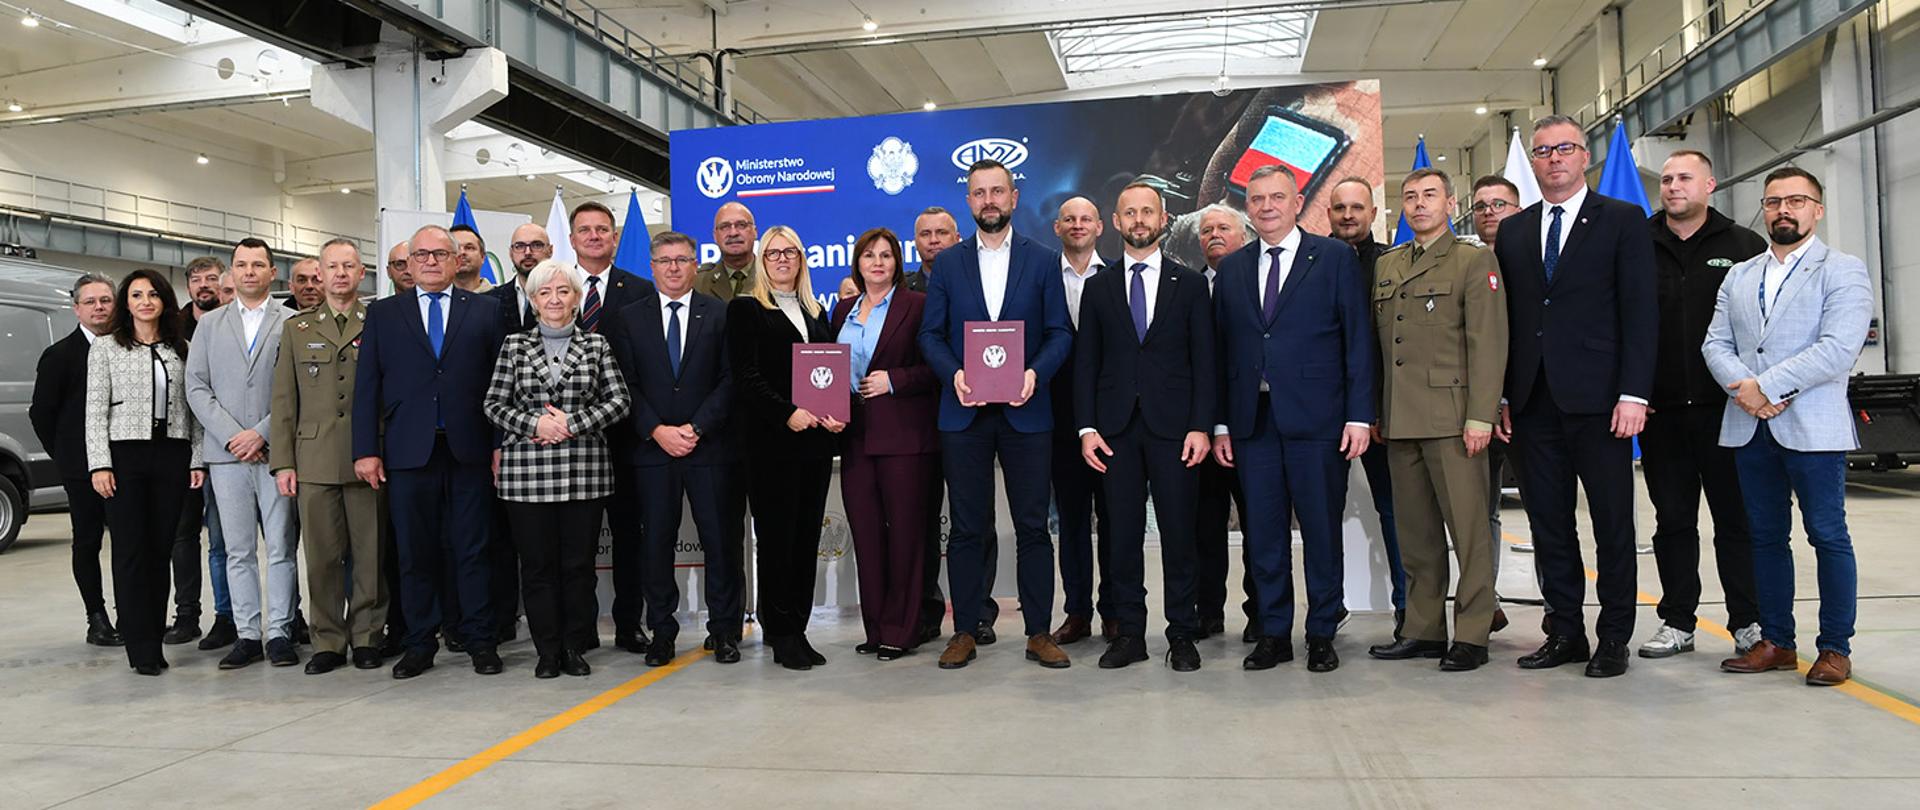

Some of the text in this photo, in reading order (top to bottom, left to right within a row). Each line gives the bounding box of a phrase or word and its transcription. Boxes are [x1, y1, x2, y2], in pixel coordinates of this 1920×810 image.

[736, 157, 804, 171] Ministerstwo
[736, 168, 835, 185] Obrony Narodowej
